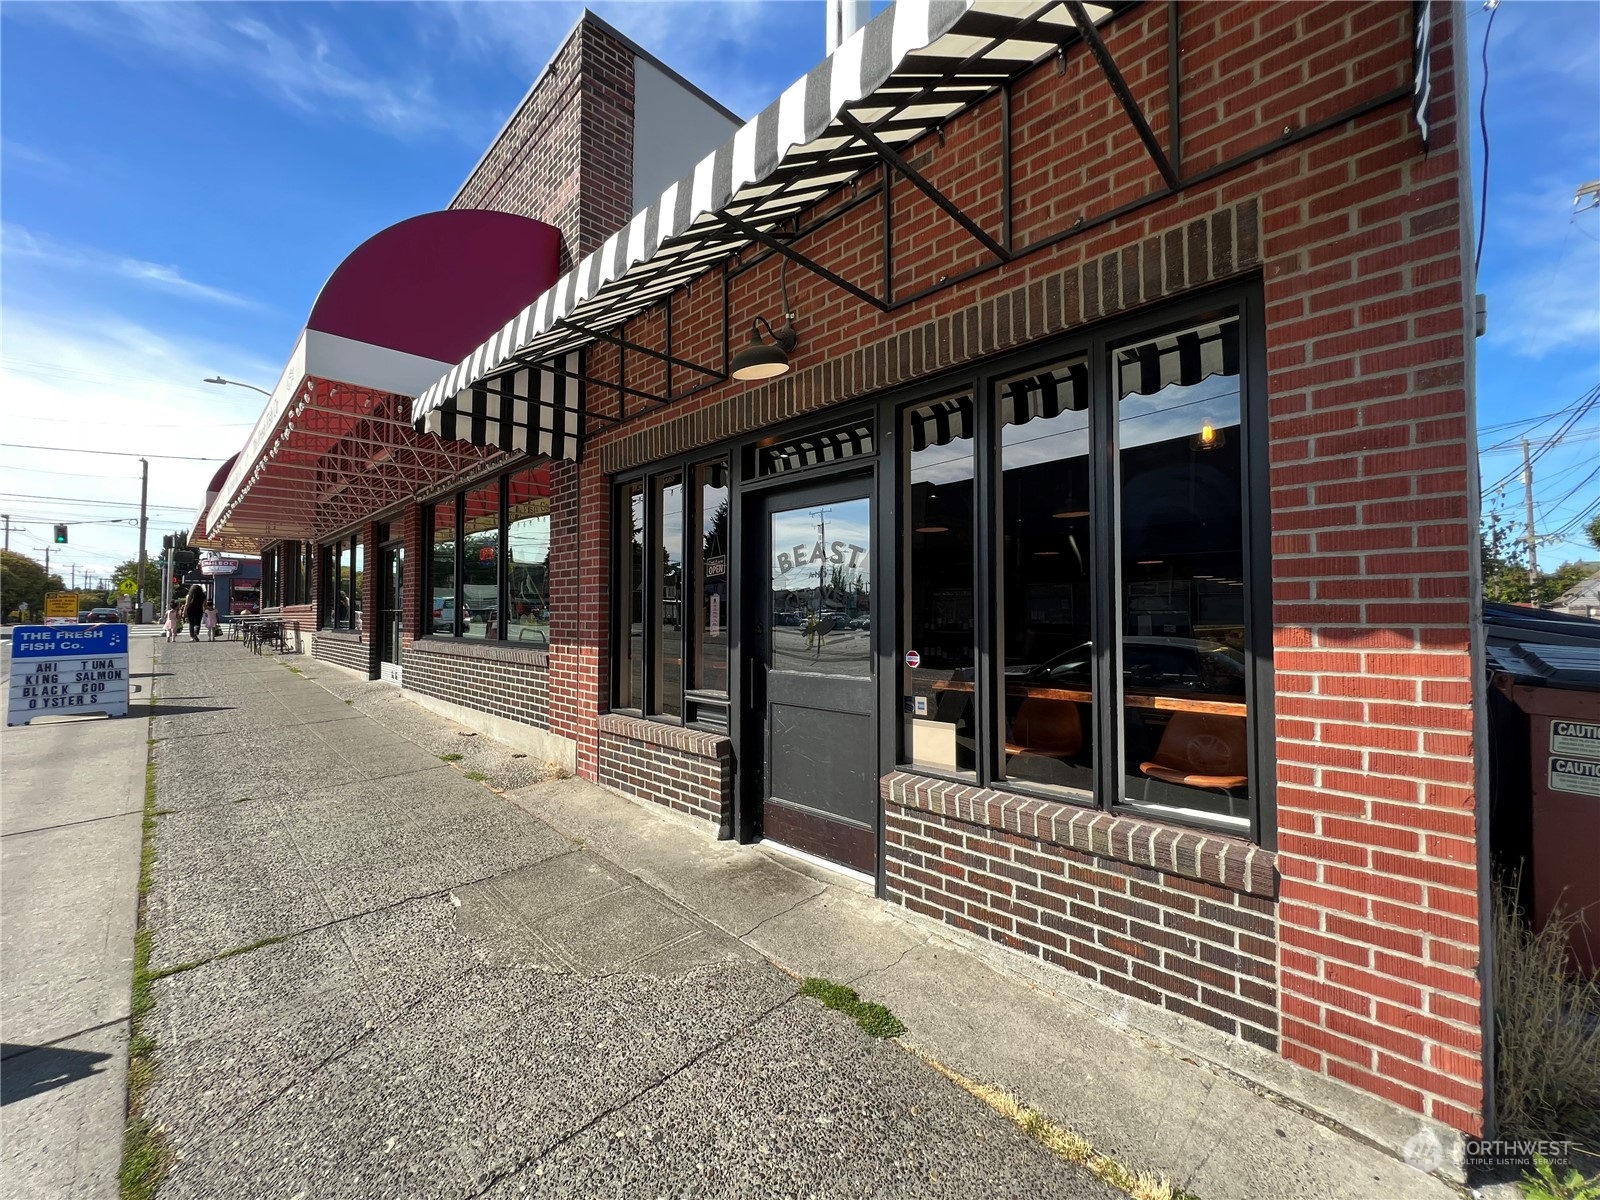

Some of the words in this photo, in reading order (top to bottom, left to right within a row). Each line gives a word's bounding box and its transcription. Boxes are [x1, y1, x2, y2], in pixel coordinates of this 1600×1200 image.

[777, 541, 864, 575] BEAST
[708, 565, 723, 575] OPEN
[20, 632, 51, 640] THE
[56, 630, 103, 640] FRESH
[20, 642, 55, 651] FISH
[60, 641, 84, 650] Co.
[36, 662, 58, 673] AHI
[25, 674, 59, 685] KING
[75, 670, 122, 682] SALMON
[23, 684, 69, 697] BLACK
[81, 682, 105, 693] COD
[1557, 723, 1600, 739] CAUTI
